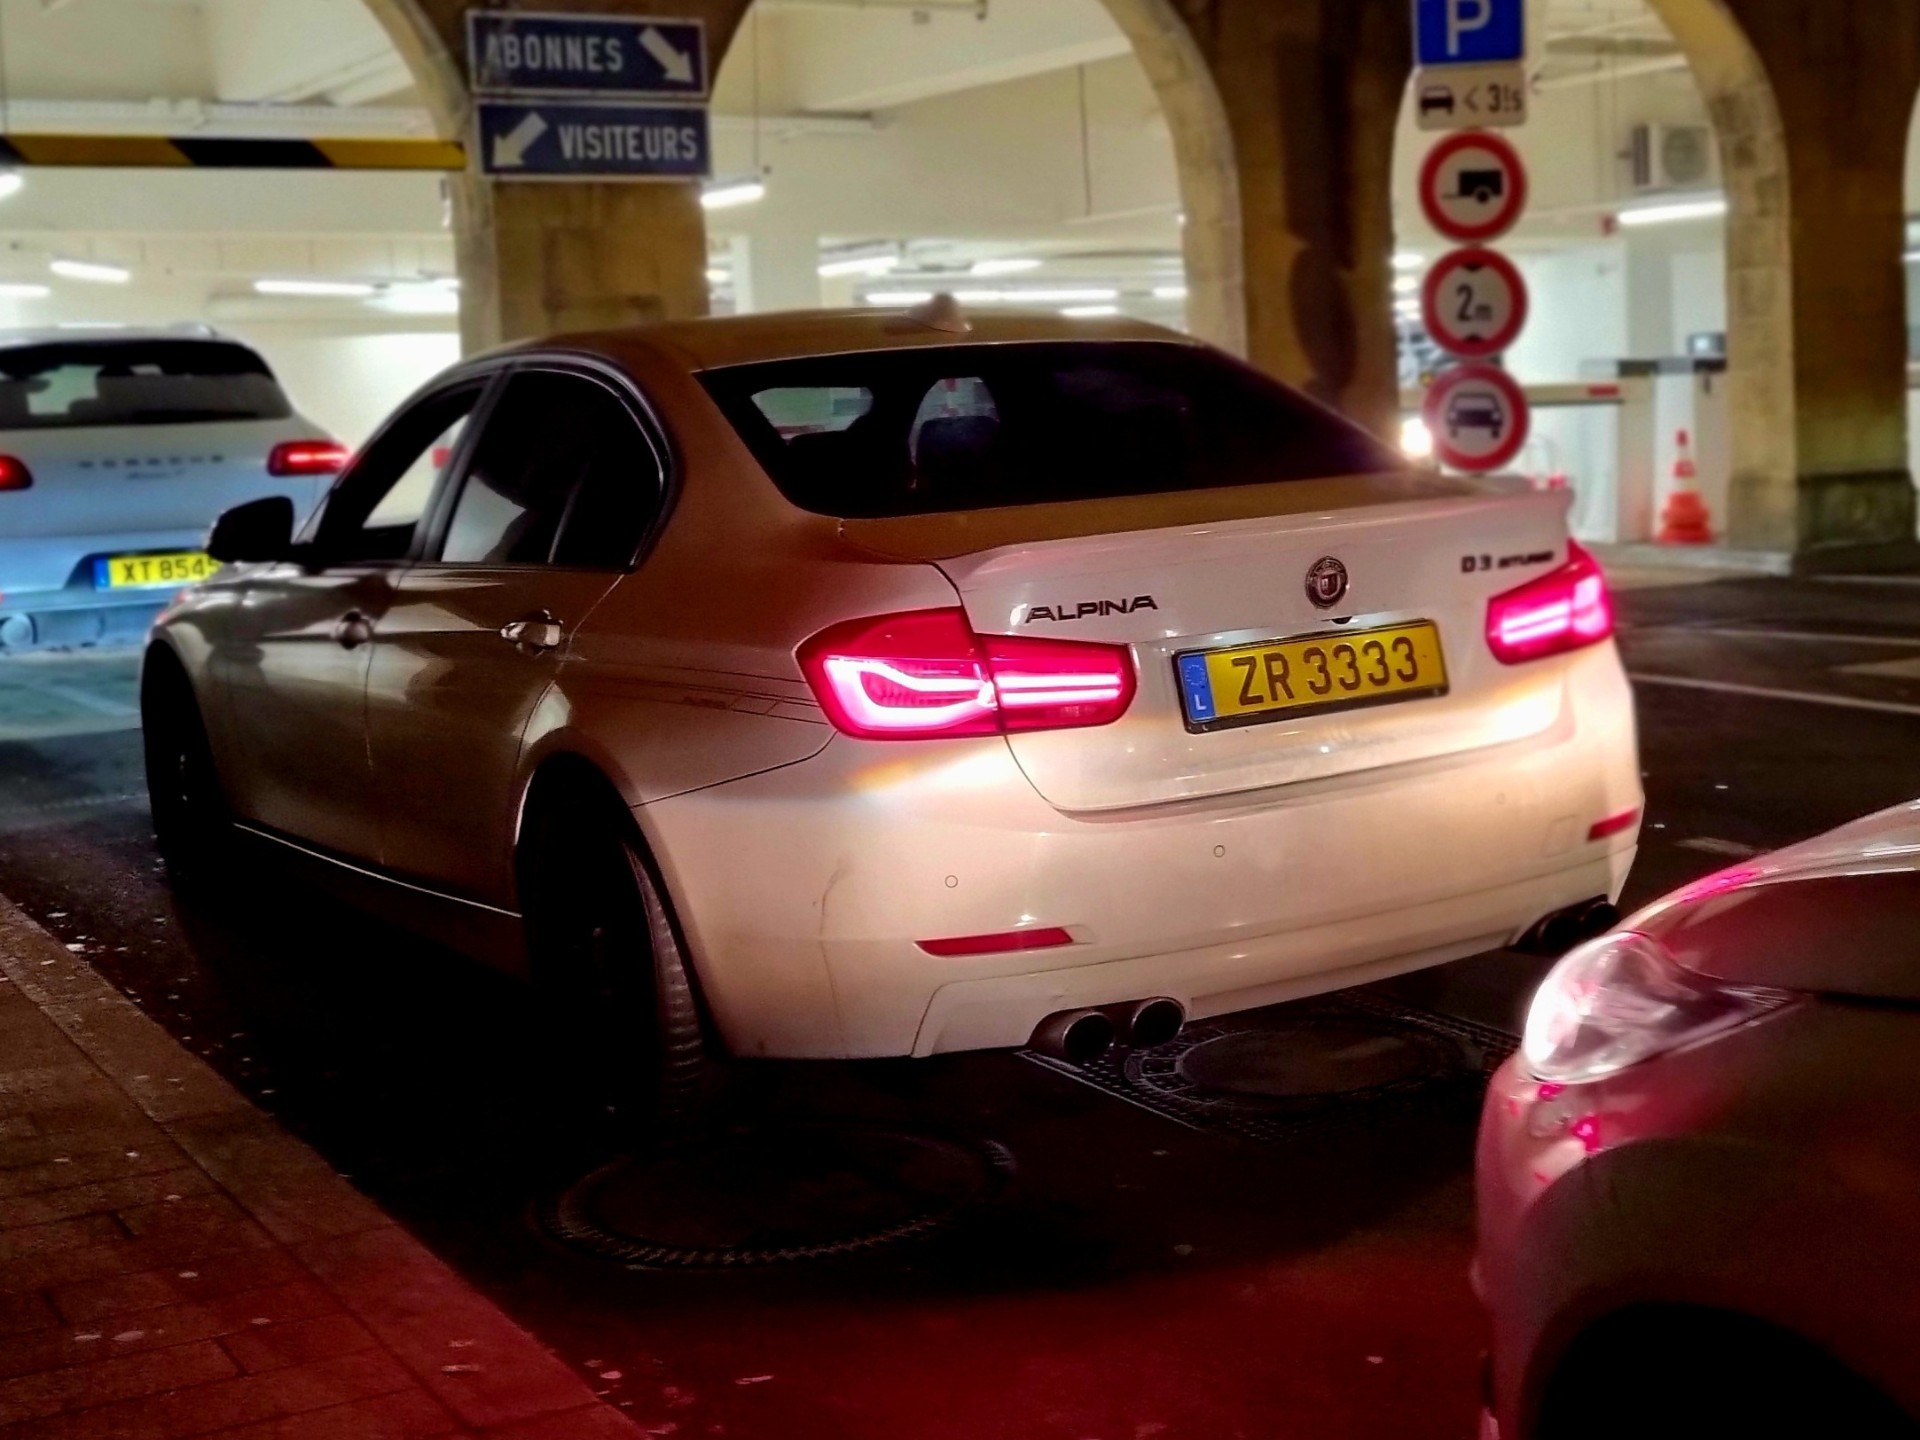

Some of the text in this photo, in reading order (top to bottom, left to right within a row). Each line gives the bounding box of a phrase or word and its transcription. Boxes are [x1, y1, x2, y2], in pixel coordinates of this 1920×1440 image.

[1446, 0, 1491, 55] P
[485, 33, 623, 72] ABONNES
[557, 125, 698, 160] VISITEURS
[123, 560, 152, 582] XT
[1025, 595, 1158, 624] ALPINA
[1232, 636, 1418, 706] ZR 3333
[1195, 694, 1207, 711] L
